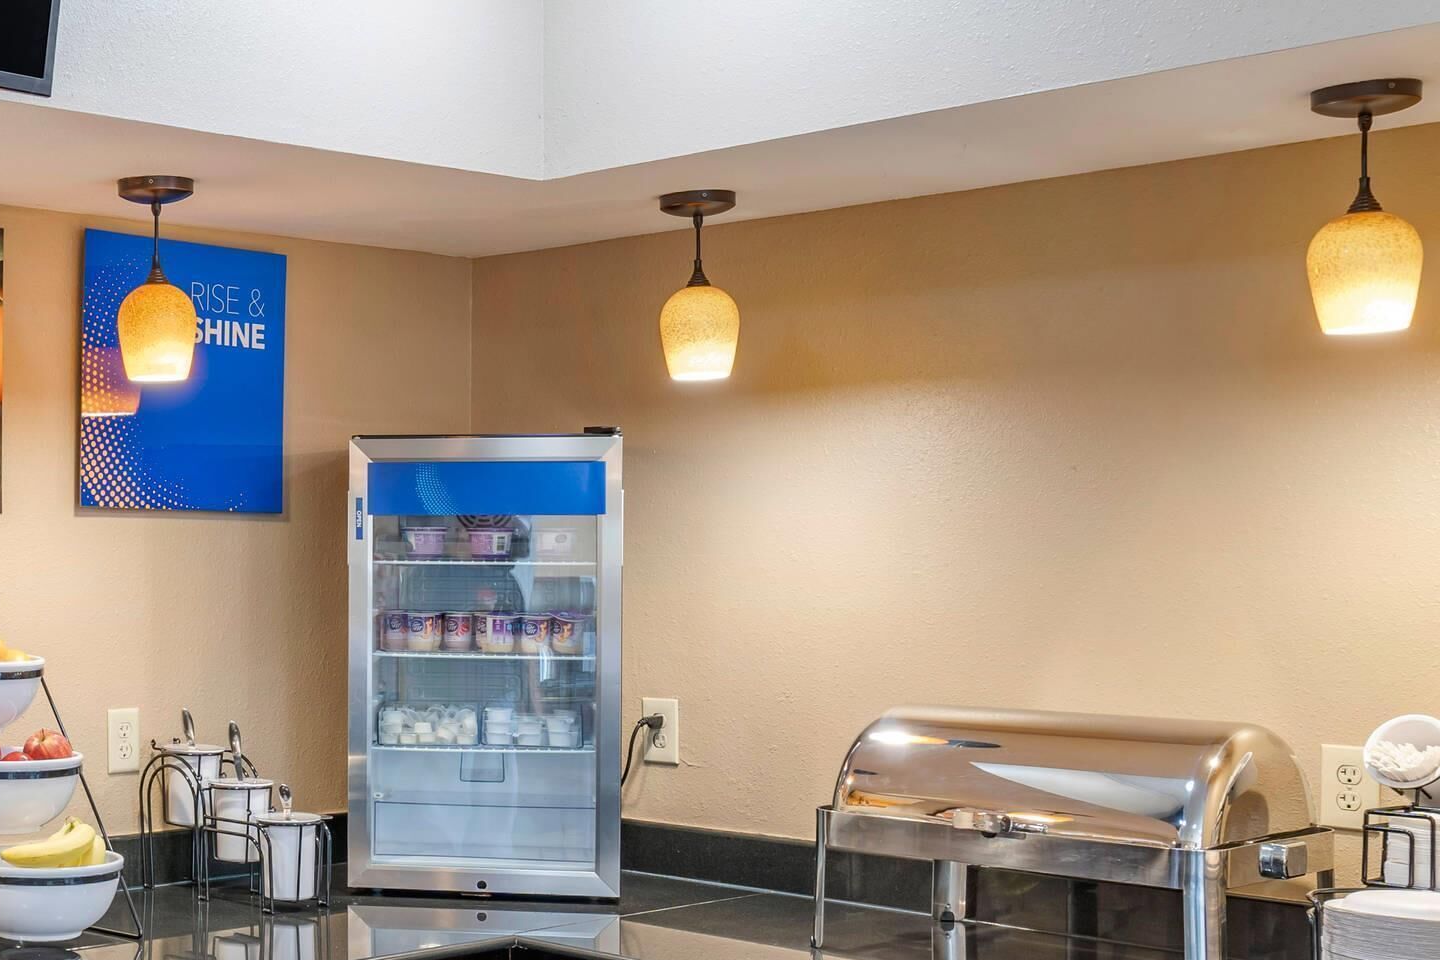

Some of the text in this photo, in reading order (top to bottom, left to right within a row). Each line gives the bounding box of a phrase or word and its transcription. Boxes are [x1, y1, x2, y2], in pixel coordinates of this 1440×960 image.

[191, 281, 265, 317] RISE &
[195, 317, 265, 349] SHINE
